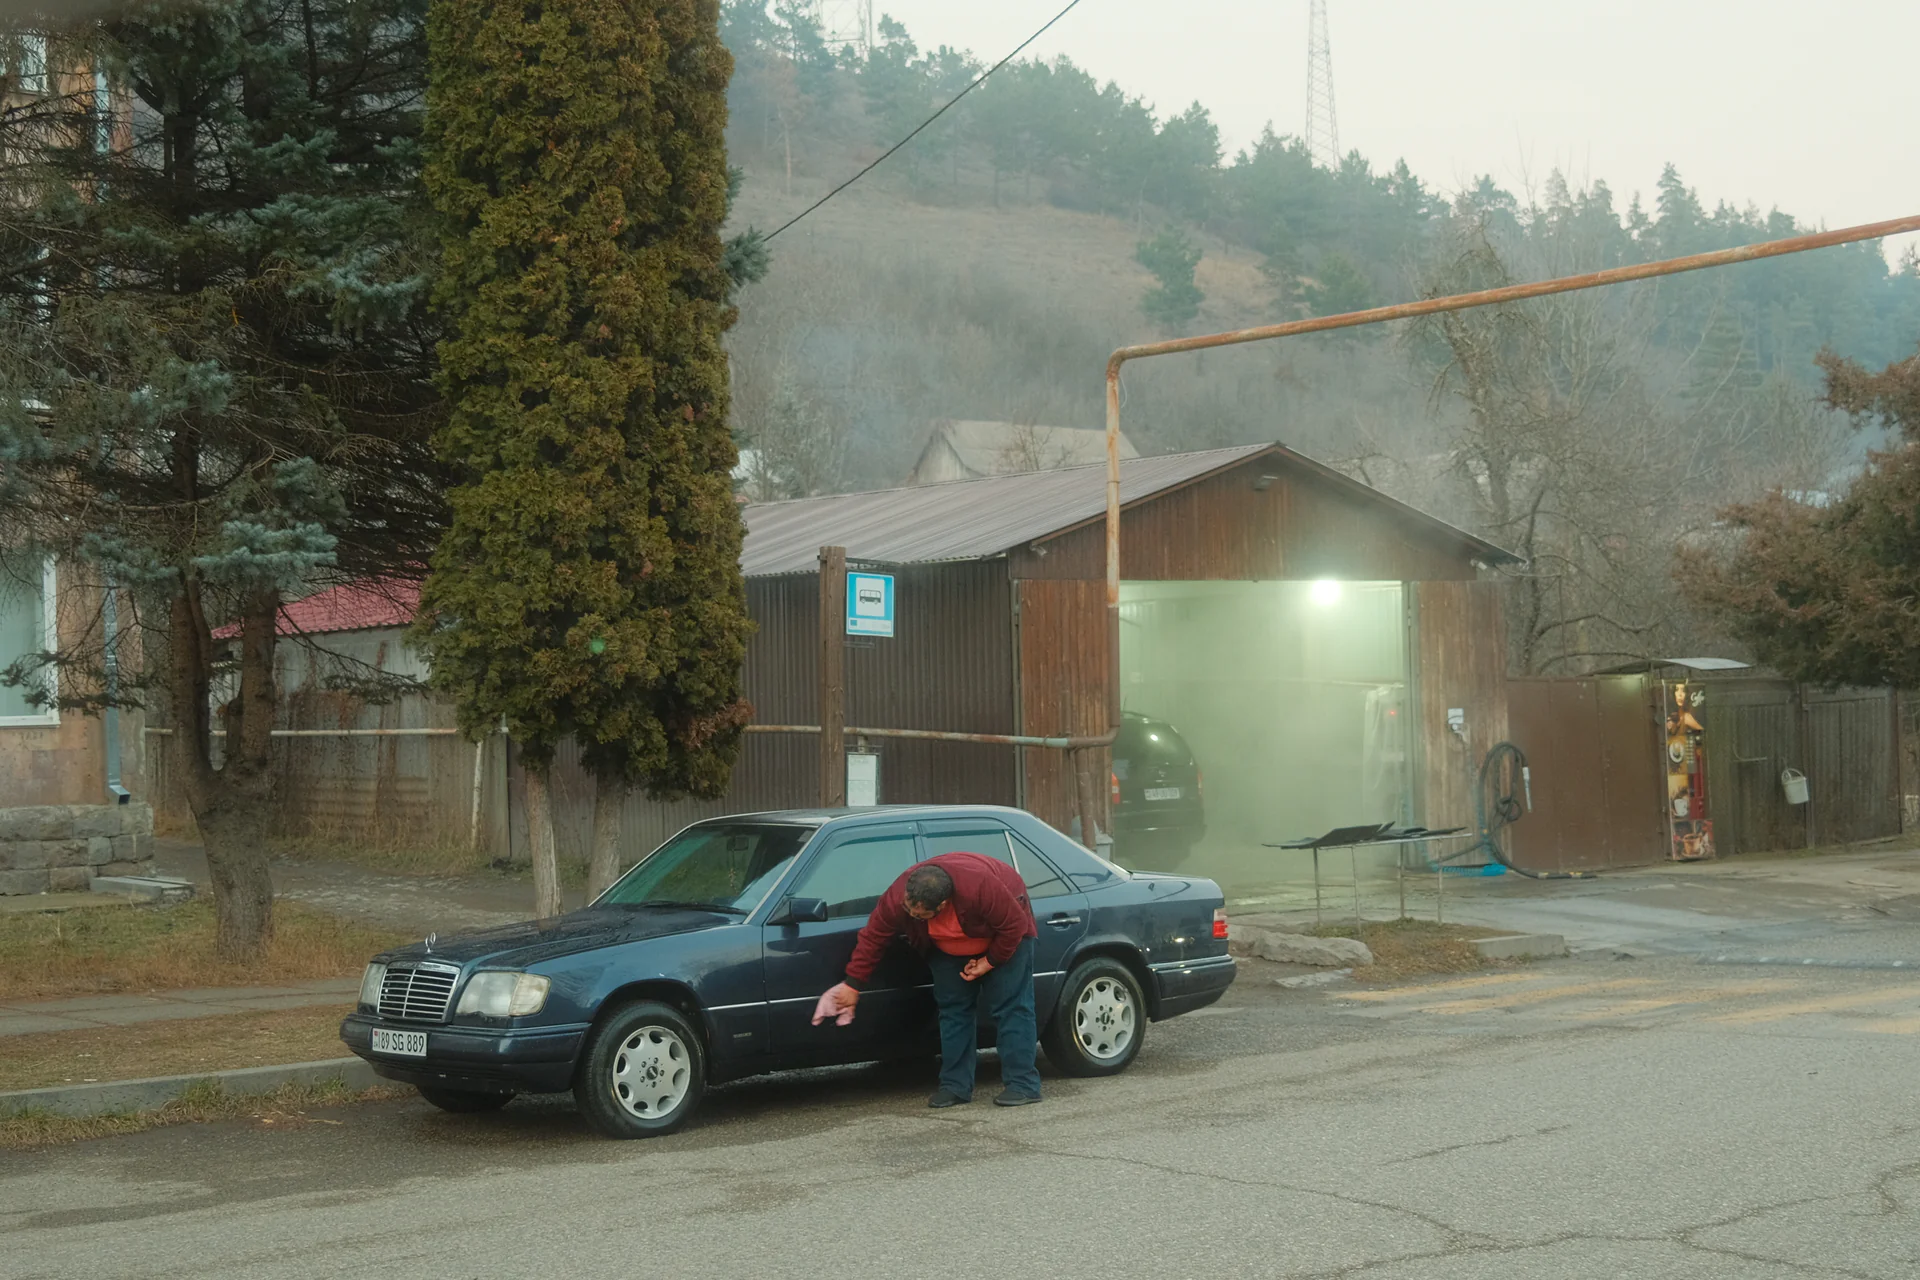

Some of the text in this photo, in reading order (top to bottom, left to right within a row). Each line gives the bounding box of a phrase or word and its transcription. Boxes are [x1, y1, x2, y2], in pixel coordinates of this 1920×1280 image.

[381, 1031, 425, 1053] 89 SG 889
